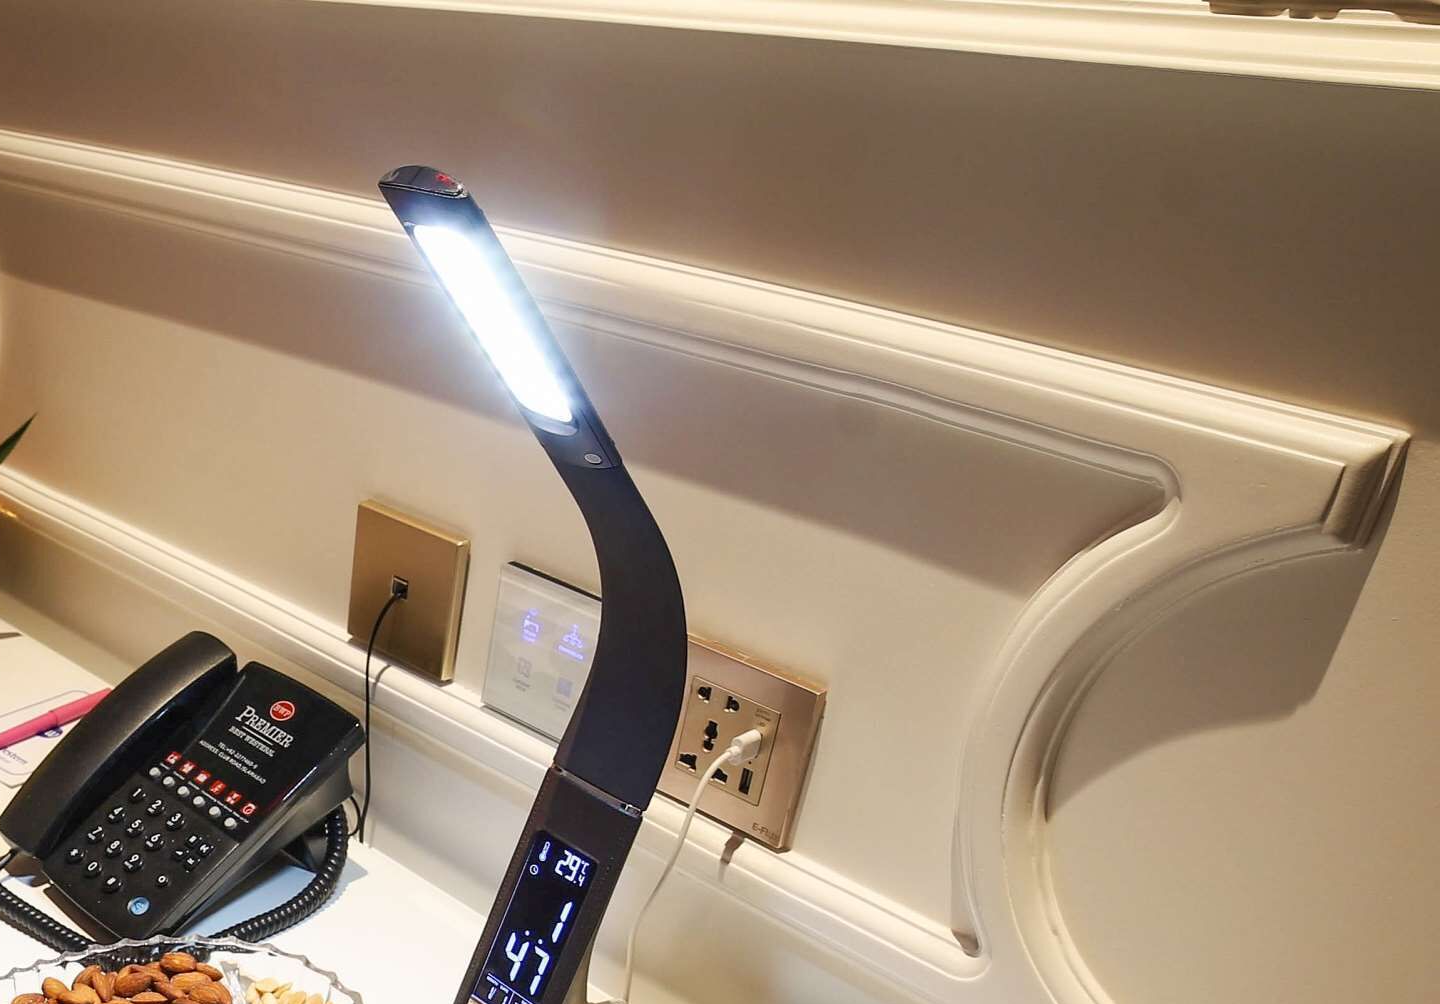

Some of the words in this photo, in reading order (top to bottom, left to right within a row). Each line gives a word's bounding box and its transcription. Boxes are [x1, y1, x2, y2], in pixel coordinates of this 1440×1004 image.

[235, 705, 294, 748] PREMIER
[228, 725, 247, 739] BEST
[243, 734, 276, 757] WESTERN
[152, 800, 162, 809] 2
[113, 807, 123, 815] 4
[171, 813, 181, 822] 3
[131, 819, 142, 829] 5
[151, 833, 161, 842] 6
[110, 840, 120, 849] 8
[129, 854, 139, 863] 9
[87, 861, 98, 871] 0
